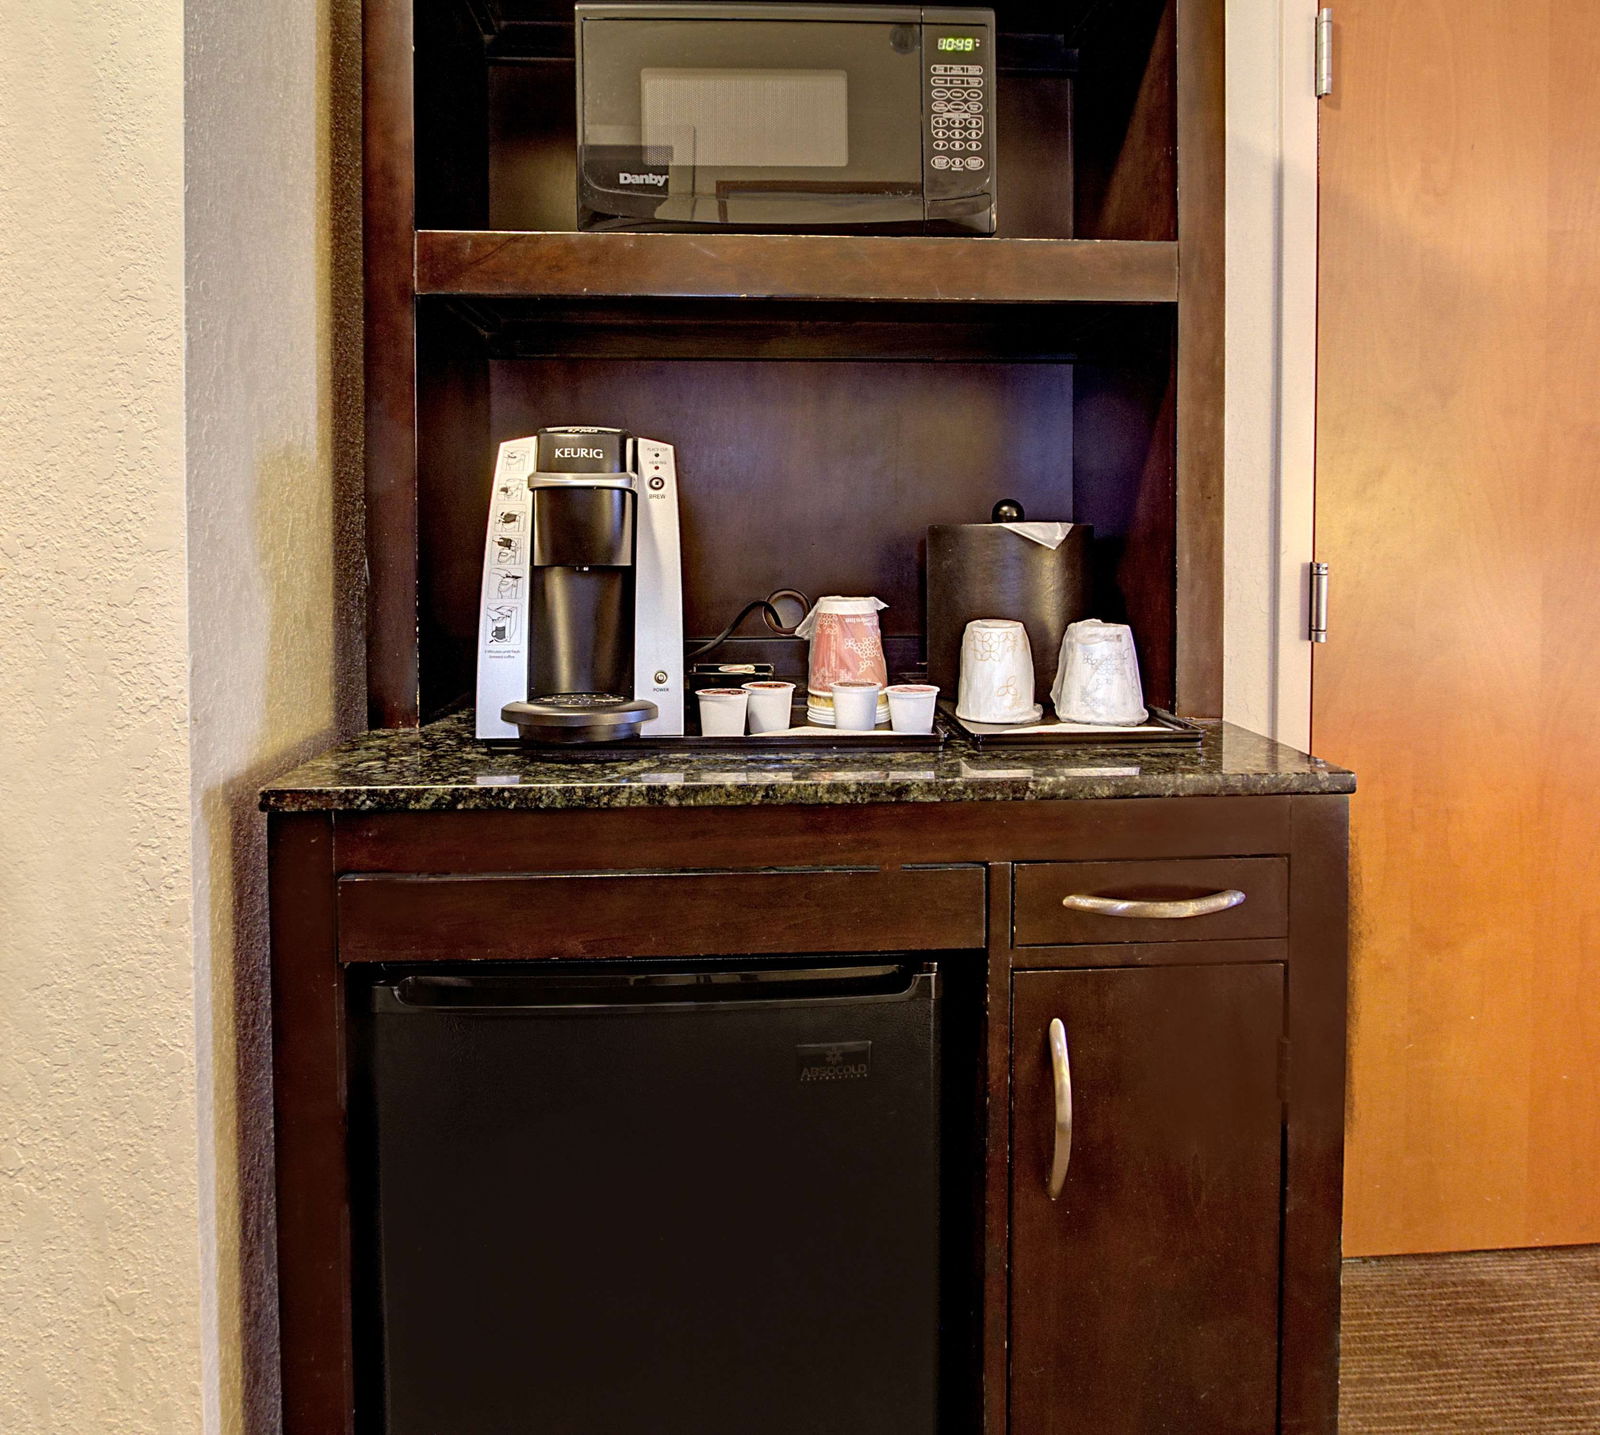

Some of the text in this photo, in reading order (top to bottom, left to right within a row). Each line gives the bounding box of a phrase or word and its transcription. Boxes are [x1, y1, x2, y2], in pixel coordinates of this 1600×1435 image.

[939, 37, 974, 51] 10:49
[619, 172, 667, 187] Danby
[554, 447, 604, 459] KEURIG
[800, 1063, 868, 1079] ABSOCOLD
